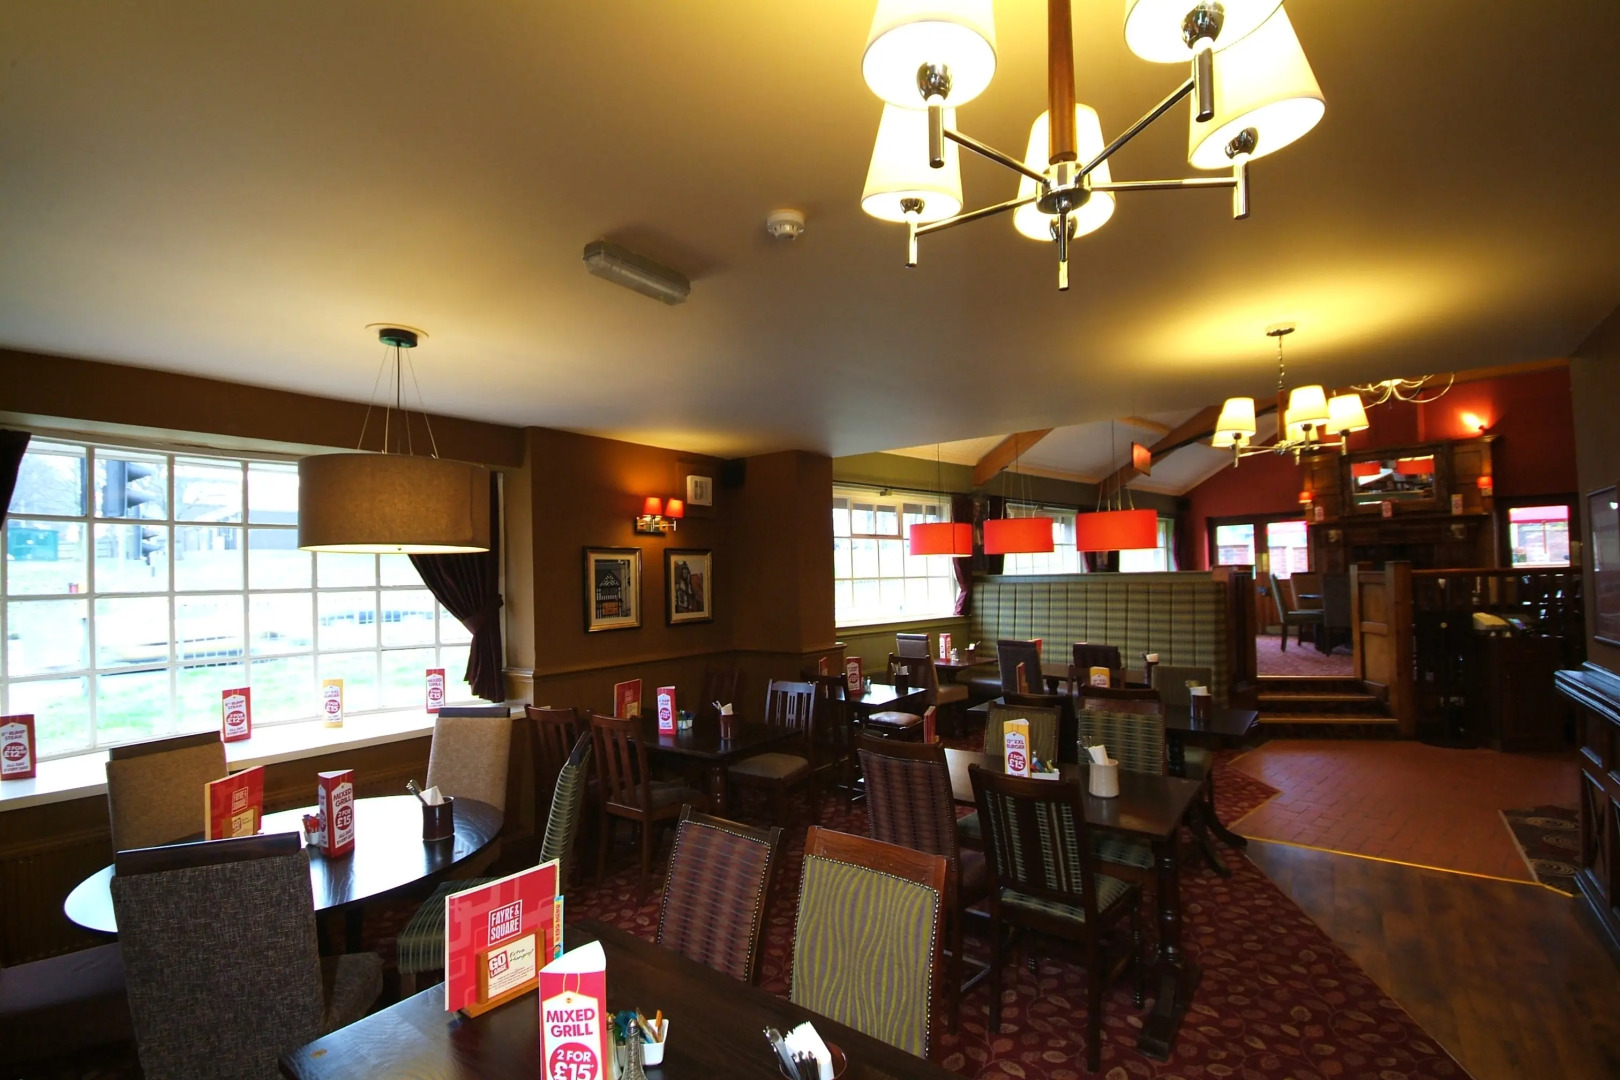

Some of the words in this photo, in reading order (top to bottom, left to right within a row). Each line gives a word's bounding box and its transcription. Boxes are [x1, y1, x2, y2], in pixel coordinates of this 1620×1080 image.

[1010, 759, 1024, 768] £15
[334, 788, 352, 801] MIXED
[336, 796, 352, 807] GRILL
[337, 815, 351, 827] £15
[491, 906, 514, 926] FAYRE
[514, 904, 519, 917] &
[491, 918, 519, 941] SQUARE
[489, 953, 506, 970] GO
[546, 1008, 595, 1022] MIXED
[551, 1023, 593, 1038] GRILL
[557, 1049, 564, 1060] 2
[566, 1050, 591, 1062] FOR
